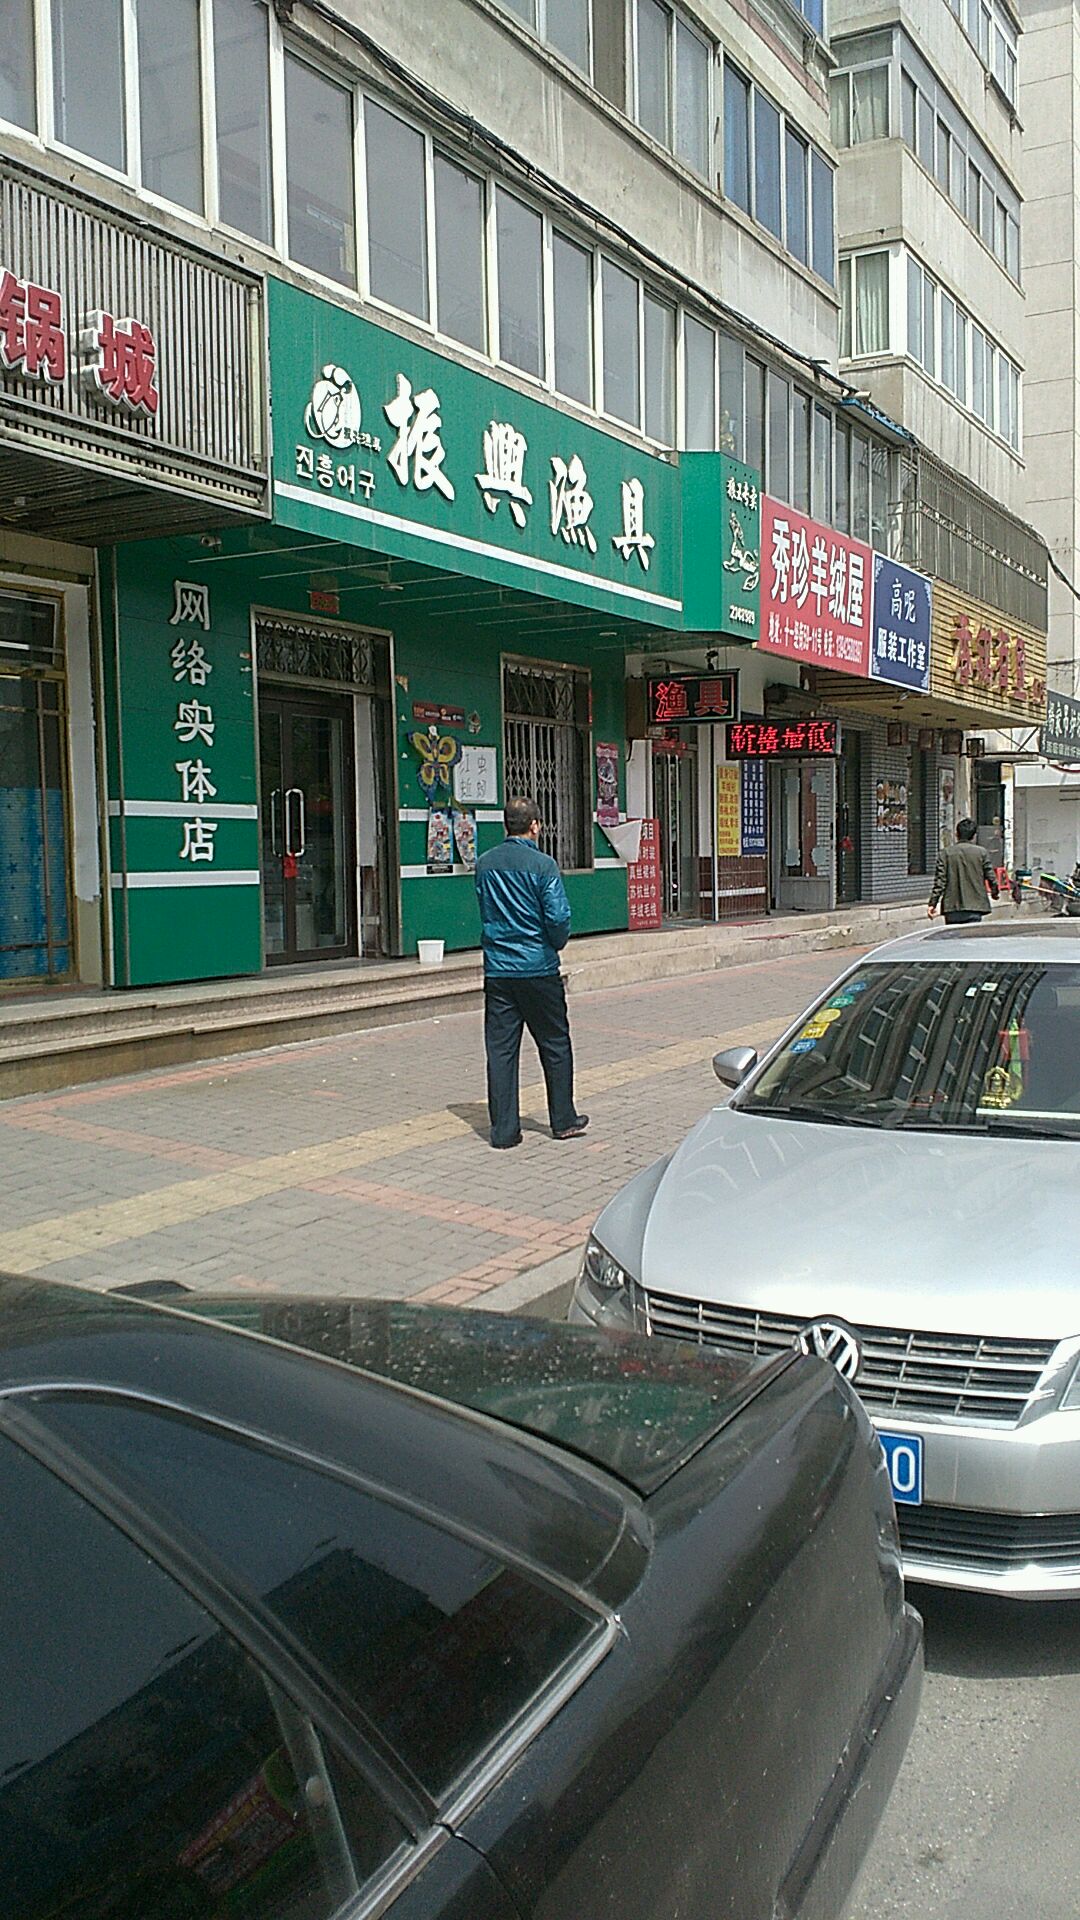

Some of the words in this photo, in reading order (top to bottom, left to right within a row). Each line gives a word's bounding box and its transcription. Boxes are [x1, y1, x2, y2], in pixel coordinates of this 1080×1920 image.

[296, 444, 376, 500] 진흥어구
[771, 517, 864, 627] 秀珍羊绒屋
[877, 627, 926, 671] 服装工作室
[169, 579, 218, 863] 网络实体店
